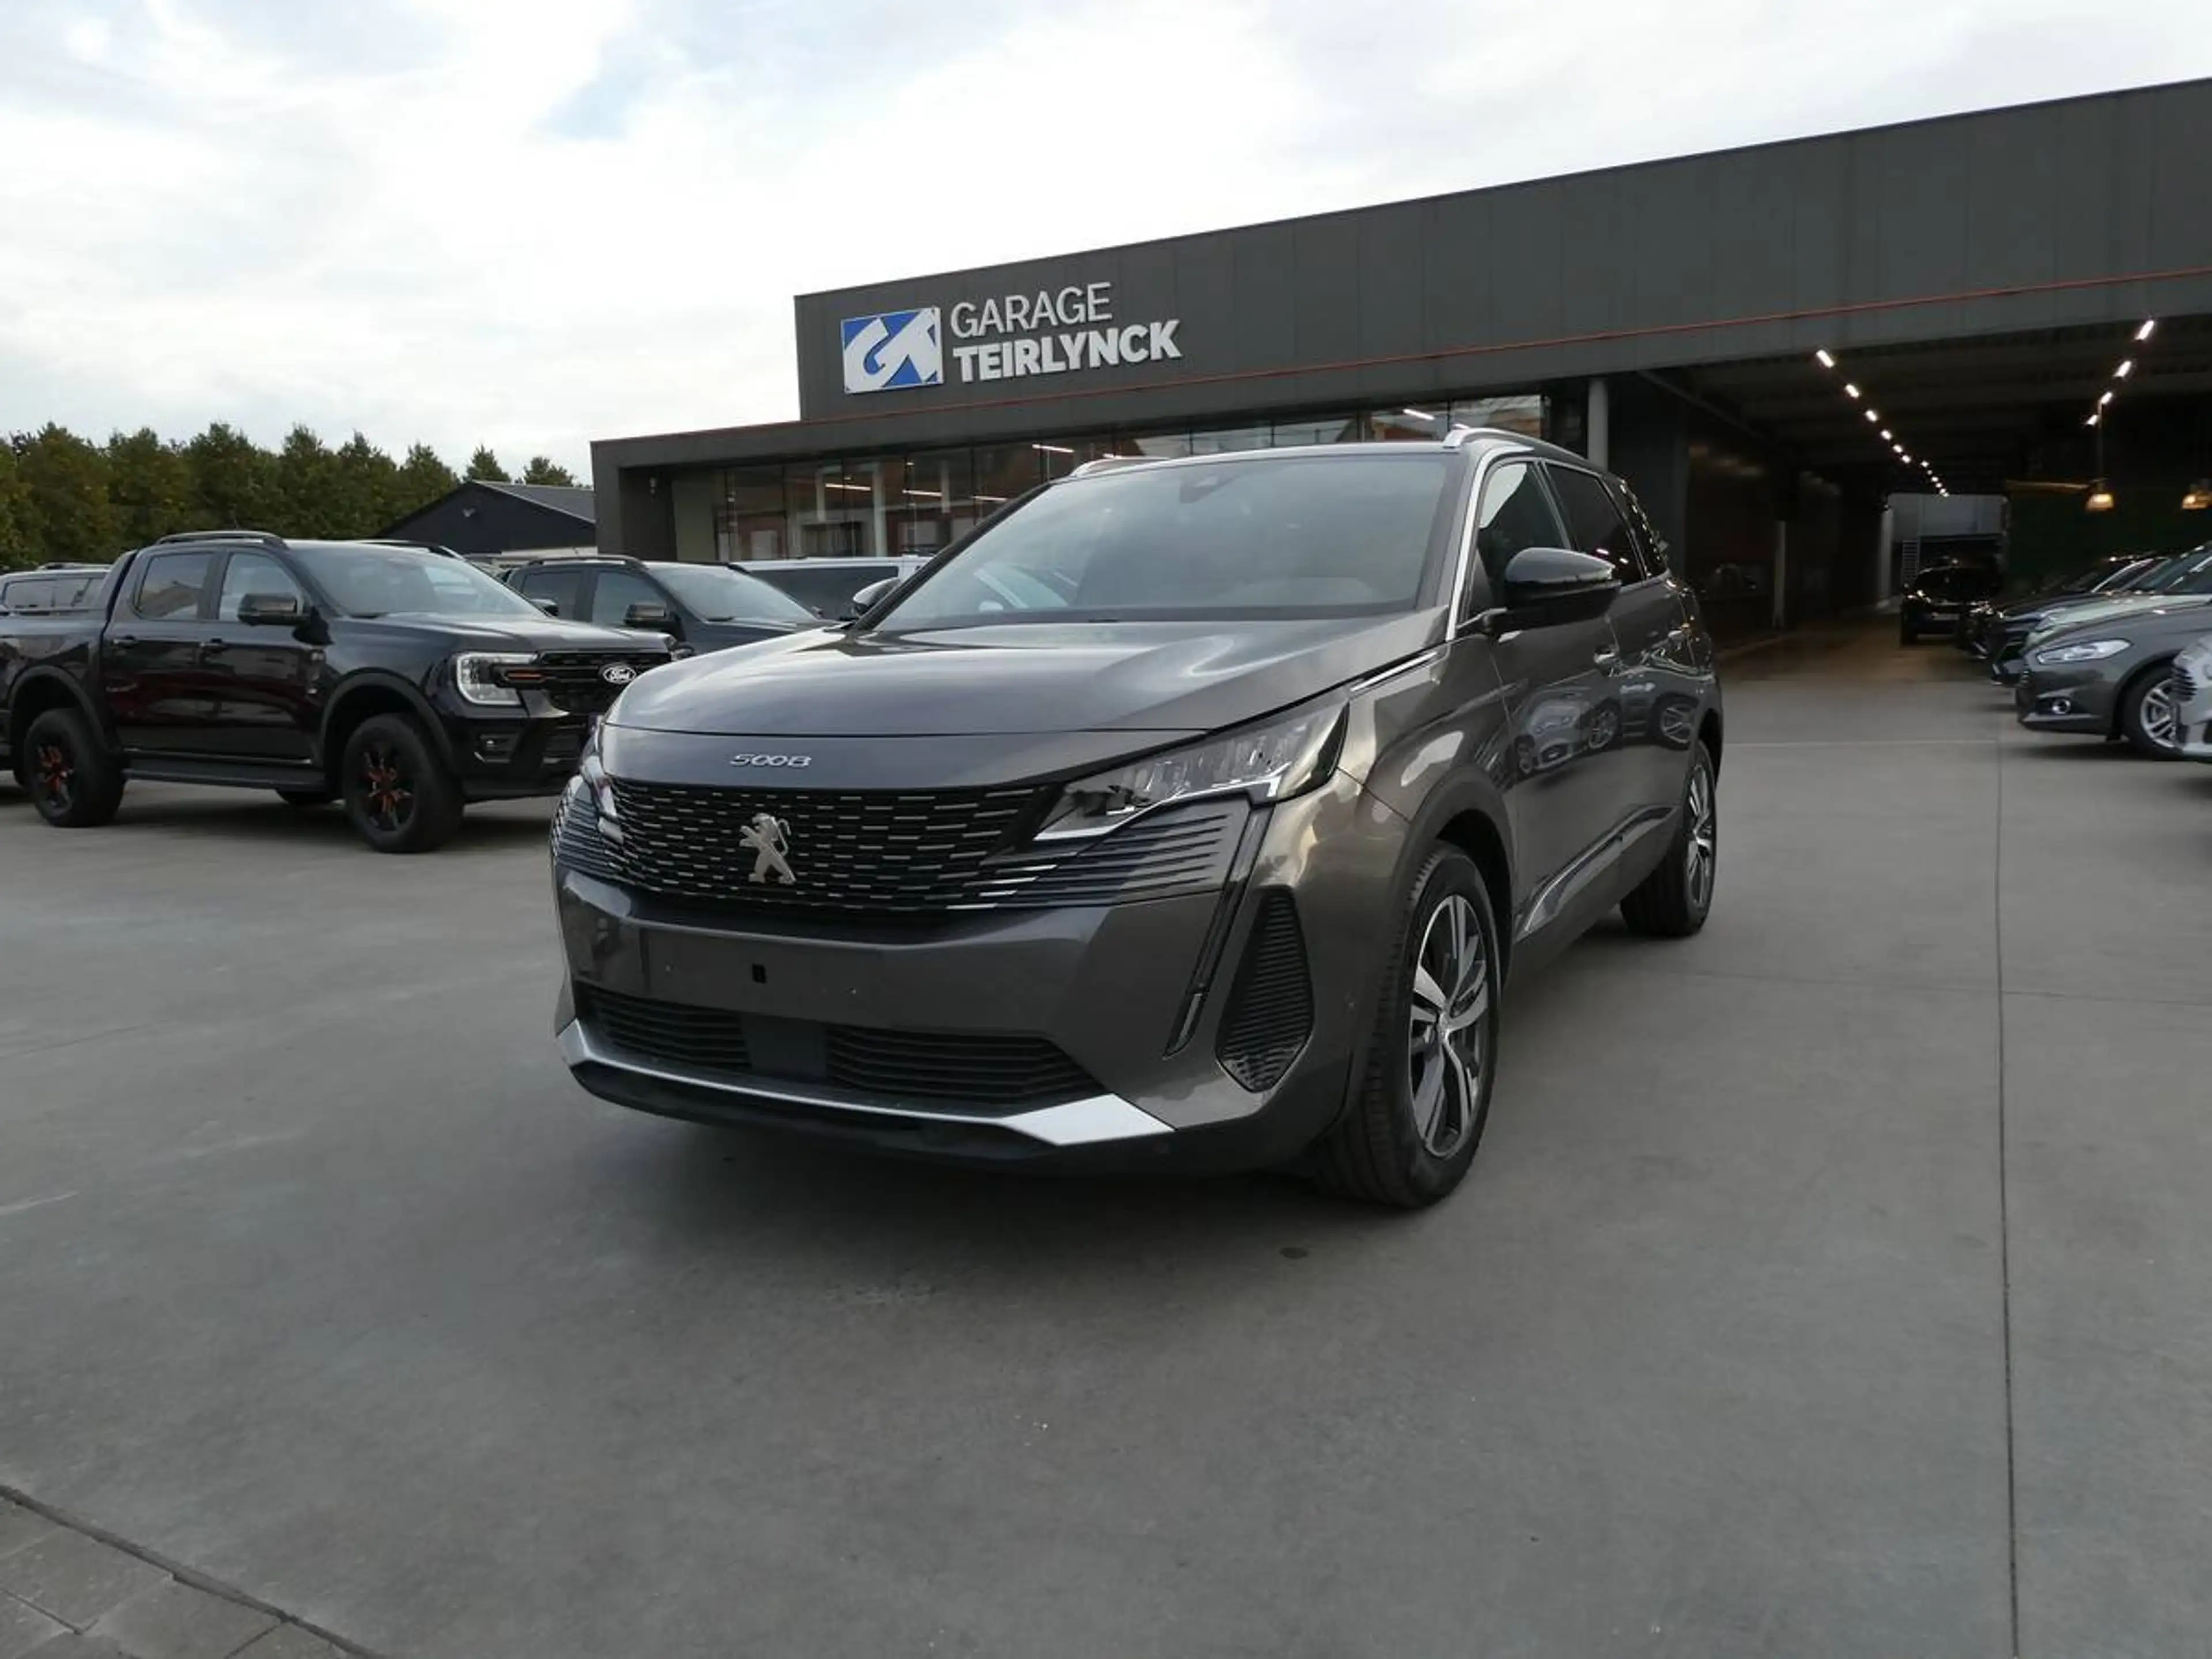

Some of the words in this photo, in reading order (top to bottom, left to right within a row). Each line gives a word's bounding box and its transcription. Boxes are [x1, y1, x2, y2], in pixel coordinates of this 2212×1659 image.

[950, 282, 1112, 338] GARAGE
[953, 320, 1181, 382] TEIRLYNCK
[730, 753, 812, 768] 5008
